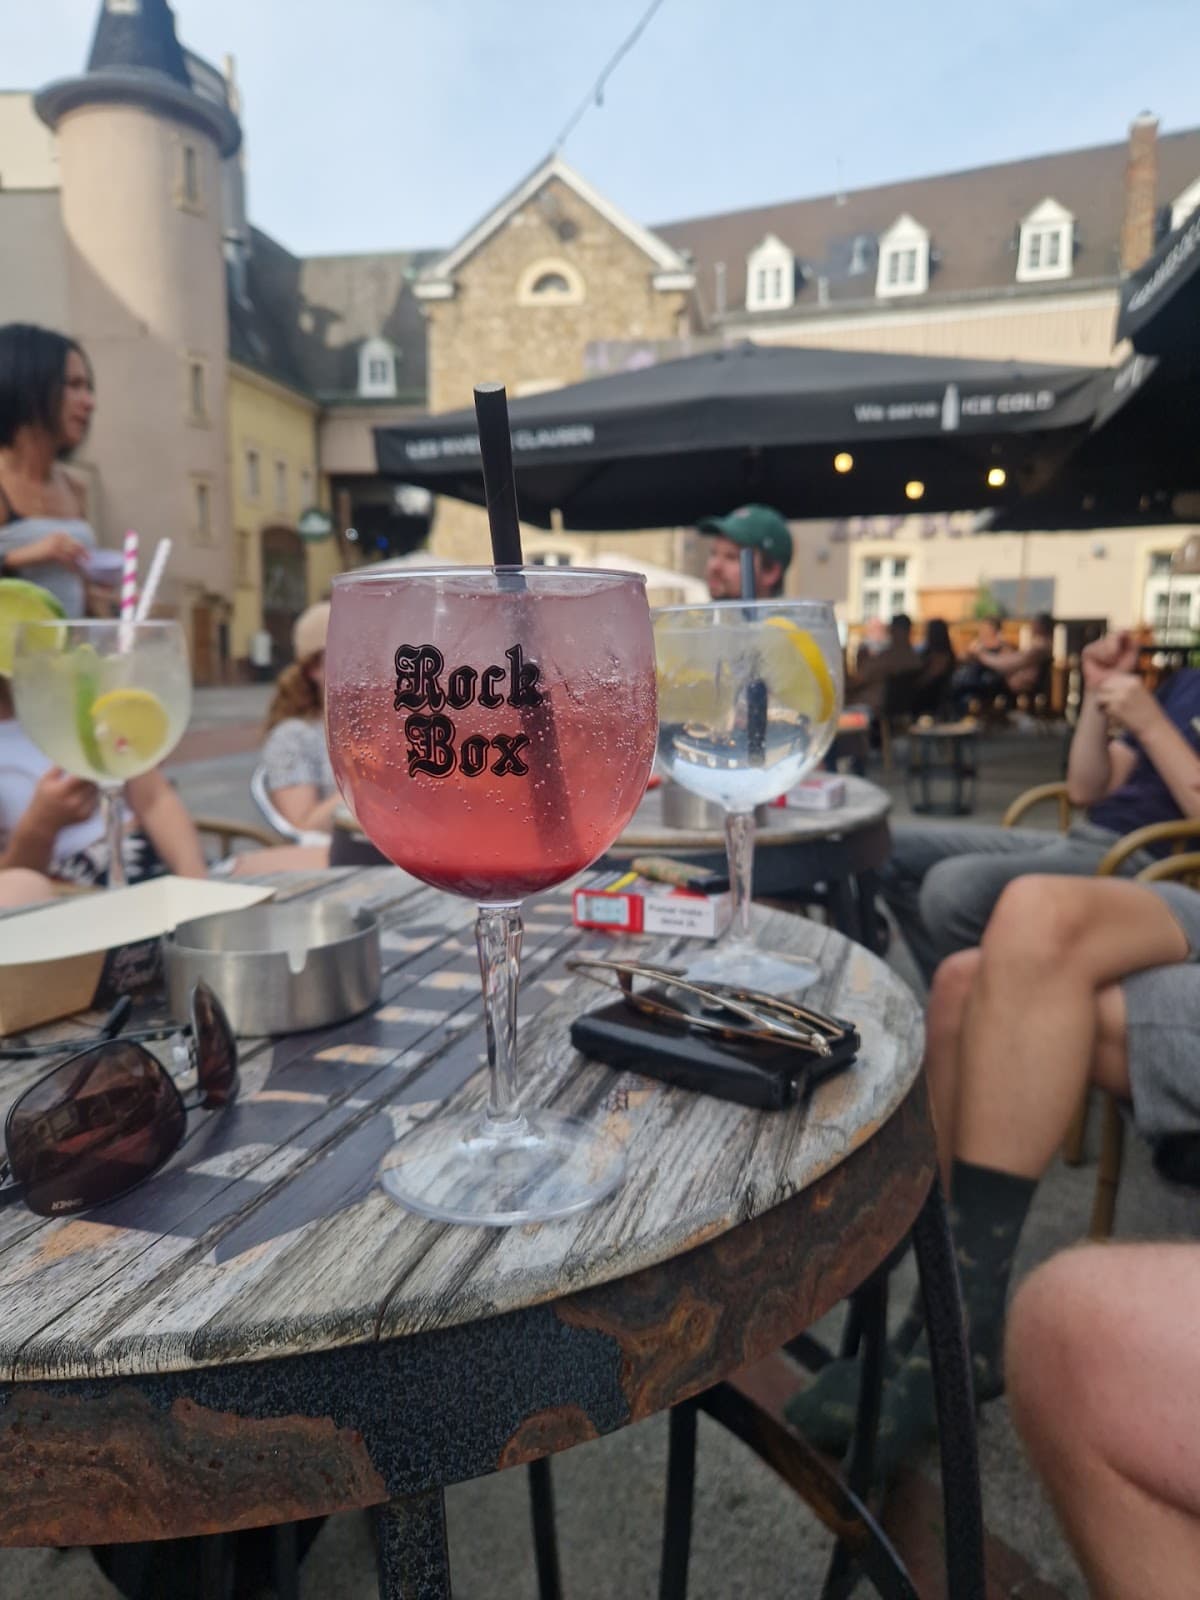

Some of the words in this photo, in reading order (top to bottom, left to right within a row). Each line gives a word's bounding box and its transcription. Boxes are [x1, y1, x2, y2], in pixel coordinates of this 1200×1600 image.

[854, 403, 884, 422] We
[887, 401, 938, 419] serve
[961, 395, 994, 415] ICE
[997, 391, 1055, 413] COLD
[406, 439, 438, 459] LES
[515, 425, 595, 449] CLAUSEN
[394, 643, 544, 712] Rock
[405, 712, 531, 779] Box
